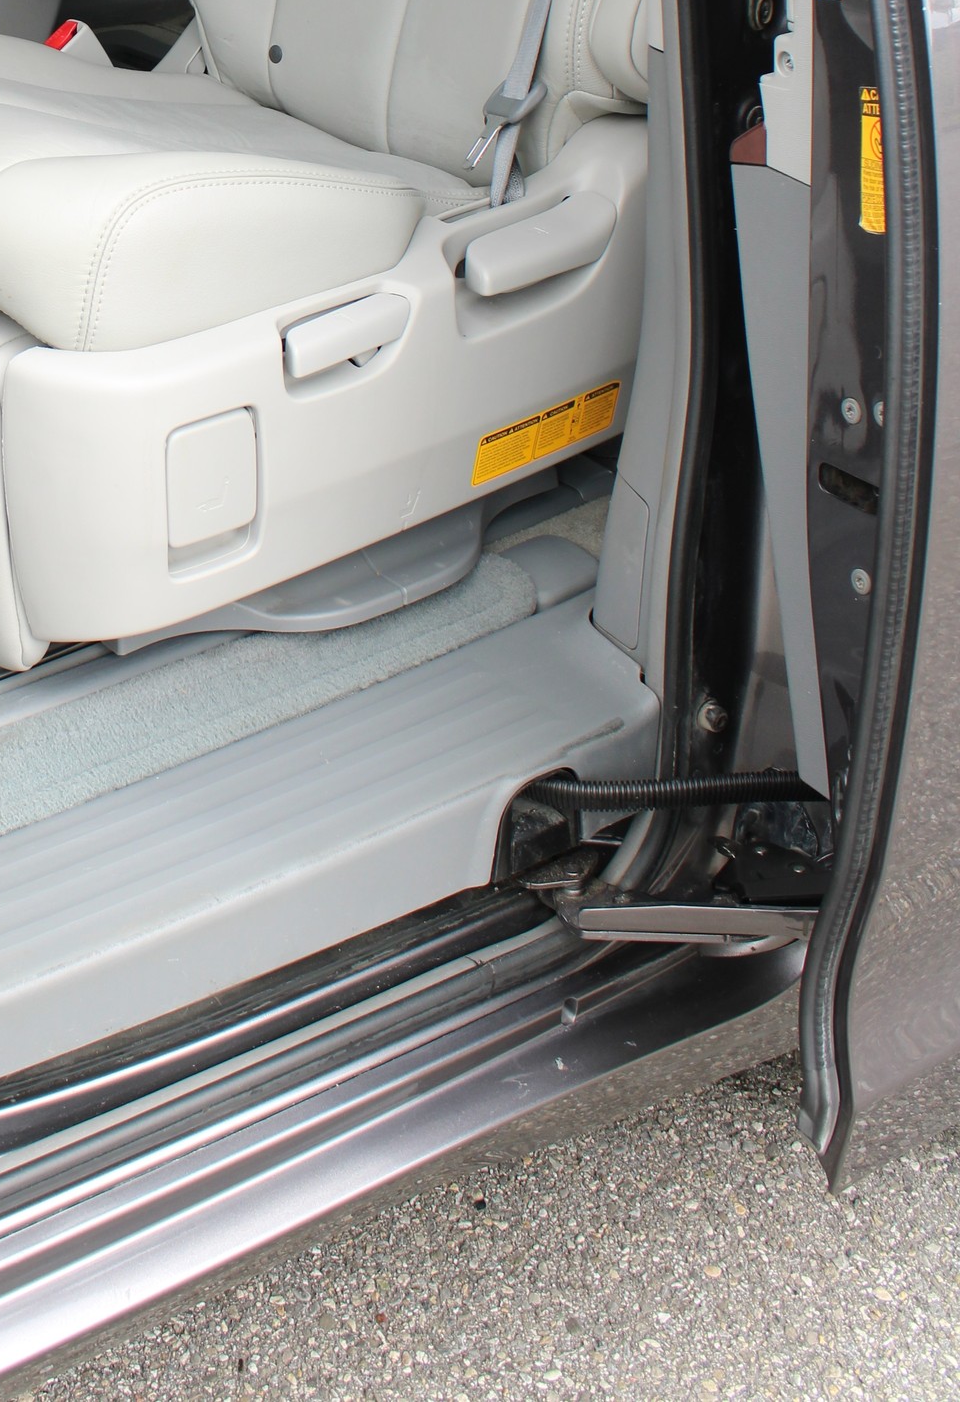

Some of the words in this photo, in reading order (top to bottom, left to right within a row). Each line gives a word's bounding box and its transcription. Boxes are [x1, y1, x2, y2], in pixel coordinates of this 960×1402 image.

[549, 405, 569, 416] CAUTION
[487, 431, 508, 443] CAUTION
[514, 418, 539, 431] ATTENTION
